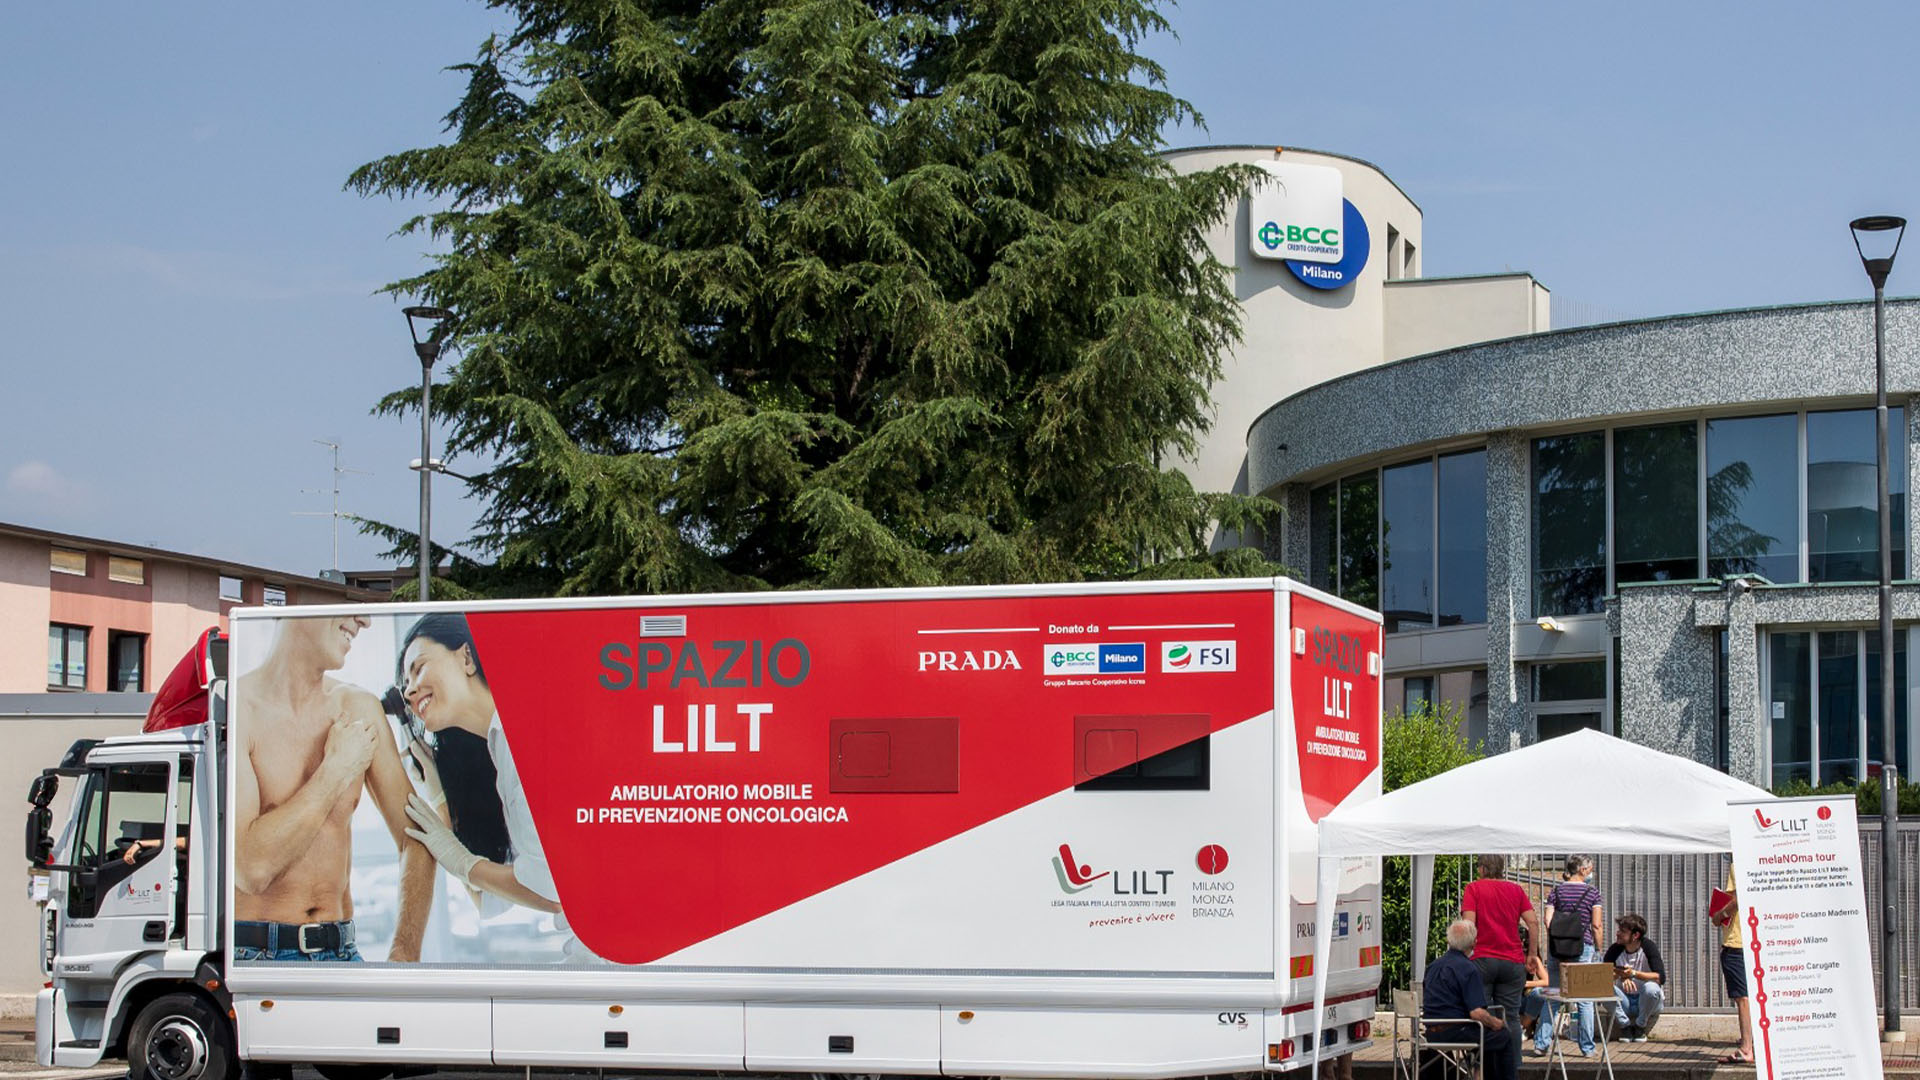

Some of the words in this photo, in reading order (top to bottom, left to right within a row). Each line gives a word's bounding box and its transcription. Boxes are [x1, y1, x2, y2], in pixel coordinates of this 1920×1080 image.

[1287, 225, 1339, 246] BCC
[1287, 243, 1306, 252] CREDITO
[1307, 244, 1339, 255] COOPERATIVO
[1303, 265, 1343, 280] Milano
[1048, 624, 1085, 634] Donato
[1087, 624, 1099, 634] da
[1200, 648, 1230, 665] FSI
[1313, 625, 1361, 675] SPAZIO
[918, 650, 1023, 671] PRADA
[1066, 651, 1096, 663] BCC
[1105, 653, 1138, 664] Milano
[598, 637, 811, 691] SPAZIO
[1043, 679, 1066, 688] Gruppo
[1092, 678, 1128, 686] Cooperativo
[1324, 676, 1352, 719] LILT
[653, 703, 773, 753] LILT
[610, 785, 738, 801] AMBULATORIO
[743, 784, 812, 800] MOBILE
[576, 808, 594, 823] DI
[599, 808, 722, 823] PREVENZIONE
[726, 807, 849, 822] ONCOLOGICA
[1781, 818, 1808, 832] LILT
[1758, 854, 1813, 865] melaNOma
[1815, 853, 1836, 862] tour
[1114, 870, 1174, 895] LILT
[1192, 881, 1235, 891] MILANO
[1192, 895, 1234, 904] MONZA
[1089, 915, 1134, 927] prevenire
[1145, 912, 1176, 922] vivere
[1192, 908, 1235, 918] BRIANZA
[1774, 911, 1799, 921] maggio
[1828, 908, 1859, 917] Maderno
[1297, 923, 1315, 938] PRAD
[1776, 937, 1802, 947] maggio
[1803, 936, 1828, 944] Milano
[1780, 963, 1805, 973] maggio
[1806, 961, 1840, 970] Carugate
[1781, 988, 1807, 998] maggio
[1808, 986, 1833, 995] Milano
[1218, 1012, 1246, 1024] CVS
[1785, 1013, 1810, 1022] maggio
[1812, 1011, 1837, 1020] Rosate
